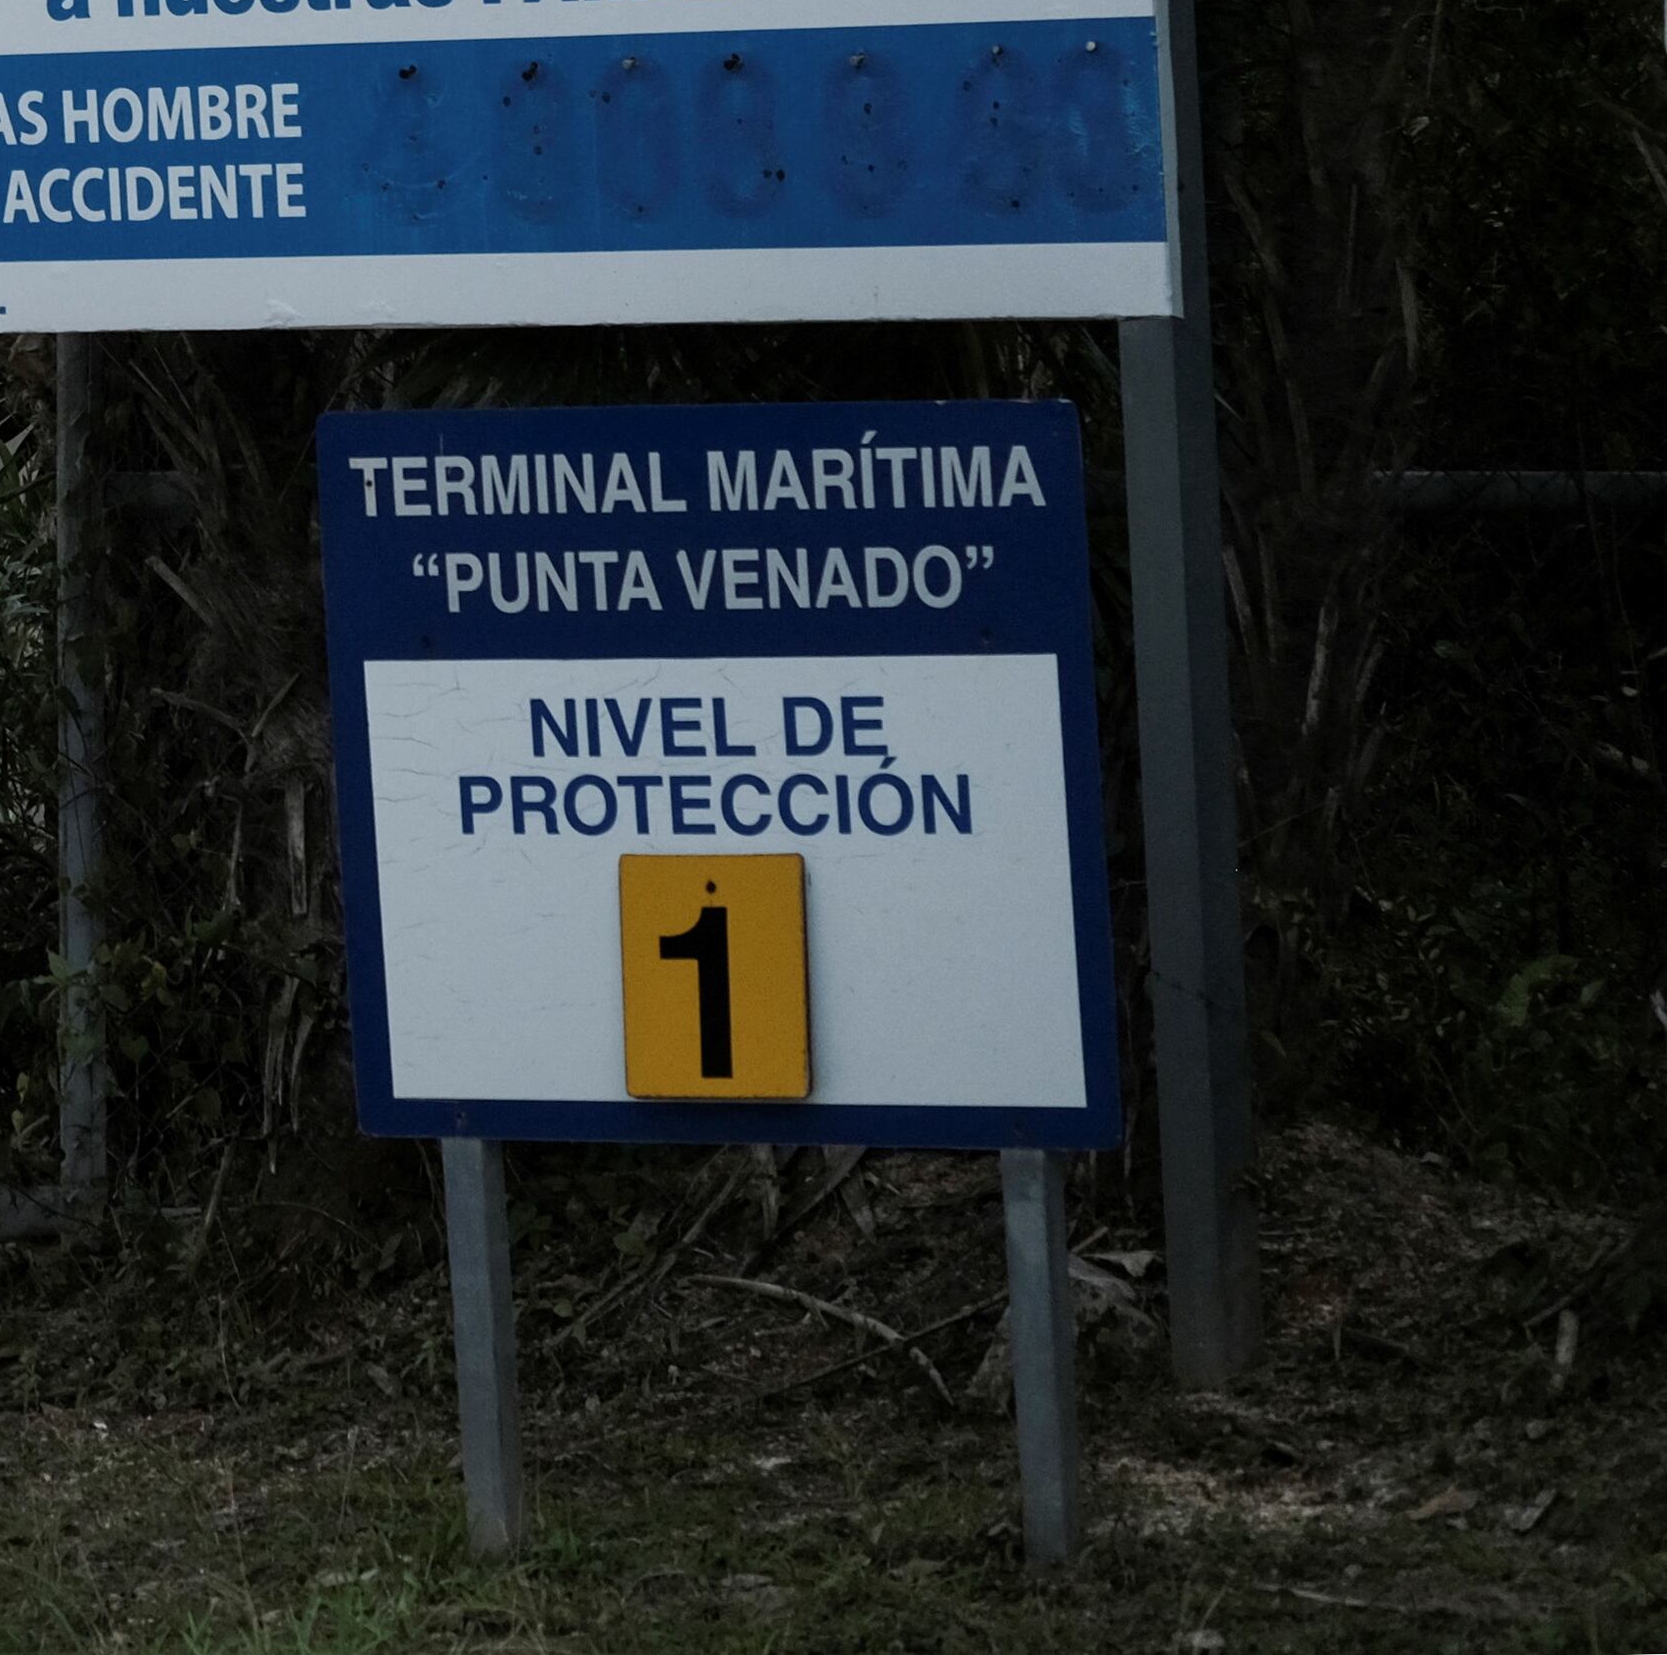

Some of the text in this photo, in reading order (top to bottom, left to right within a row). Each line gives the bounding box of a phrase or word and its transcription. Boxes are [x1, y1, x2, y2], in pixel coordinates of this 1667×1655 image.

[61, 82, 303, 144] HOMBRE
[2, 162, 307, 224] ACCIDENTE
[348, 430, 1047, 517] TERMINAL MARÍTIMA
[410, 544, 995, 614] “PUNTA VENADO”
[529, 696, 889, 758] NIVEL DE
[458, 756, 973, 837] PROTECCIÓN
[658, 906, 734, 1080] 1
